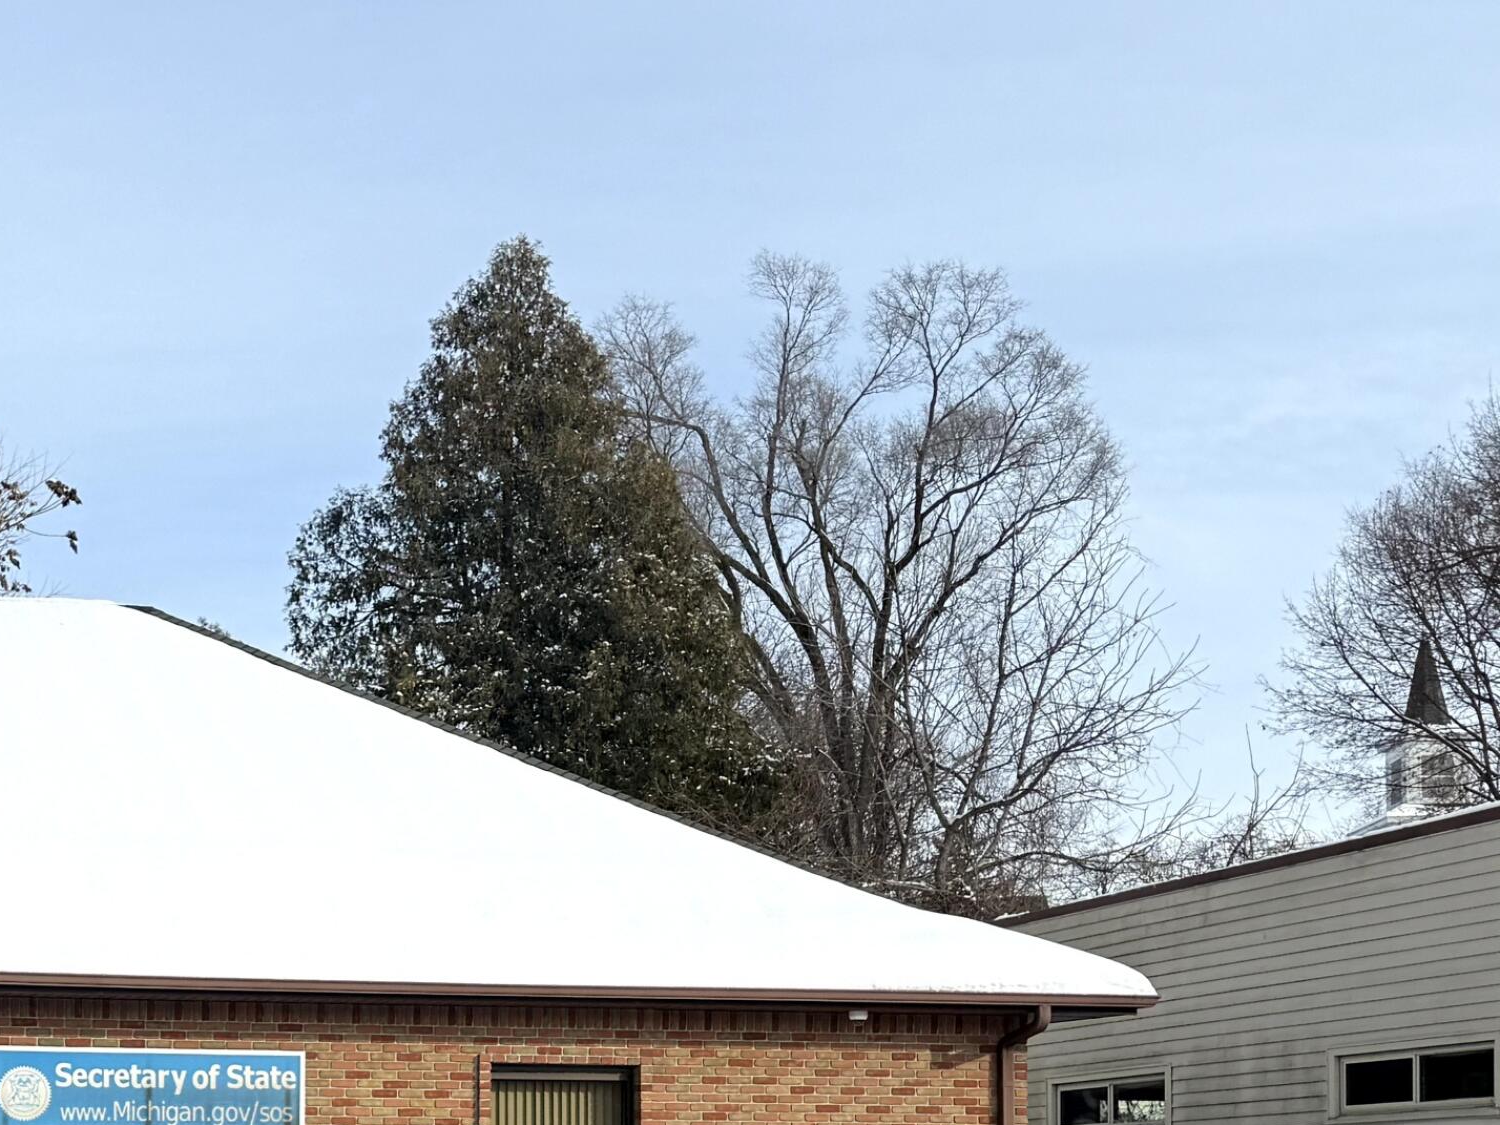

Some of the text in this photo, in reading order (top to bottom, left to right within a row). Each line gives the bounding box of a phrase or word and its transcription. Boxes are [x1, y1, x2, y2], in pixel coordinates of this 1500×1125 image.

[55, 1062, 296, 1095] Secretary of State
